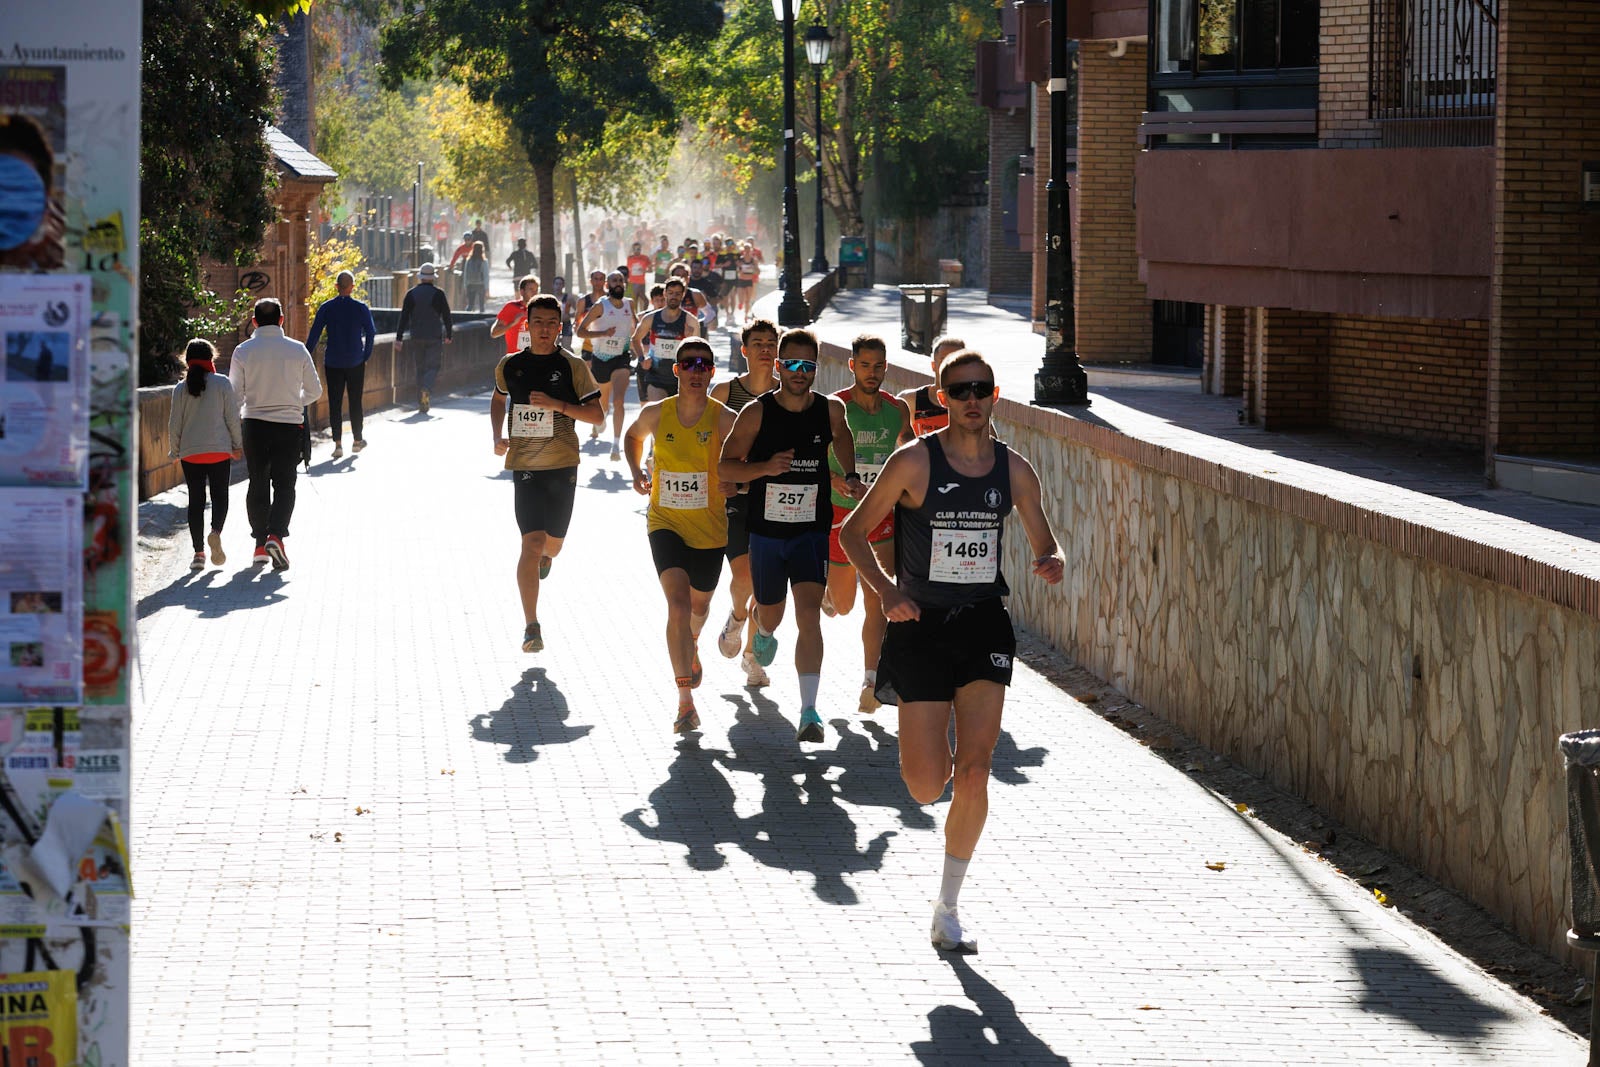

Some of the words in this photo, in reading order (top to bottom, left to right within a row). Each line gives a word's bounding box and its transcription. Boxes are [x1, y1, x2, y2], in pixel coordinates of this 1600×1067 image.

[10, 43, 125, 66] Ayuntamiento
[518, 411, 545, 422] 1497
[665, 480, 699, 492] 1154
[778, 492, 805, 505] 257
[956, 512, 998, 520] ATLETISMO
[930, 520, 957, 528] PUERTO
[944, 541, 988, 558] 1469
